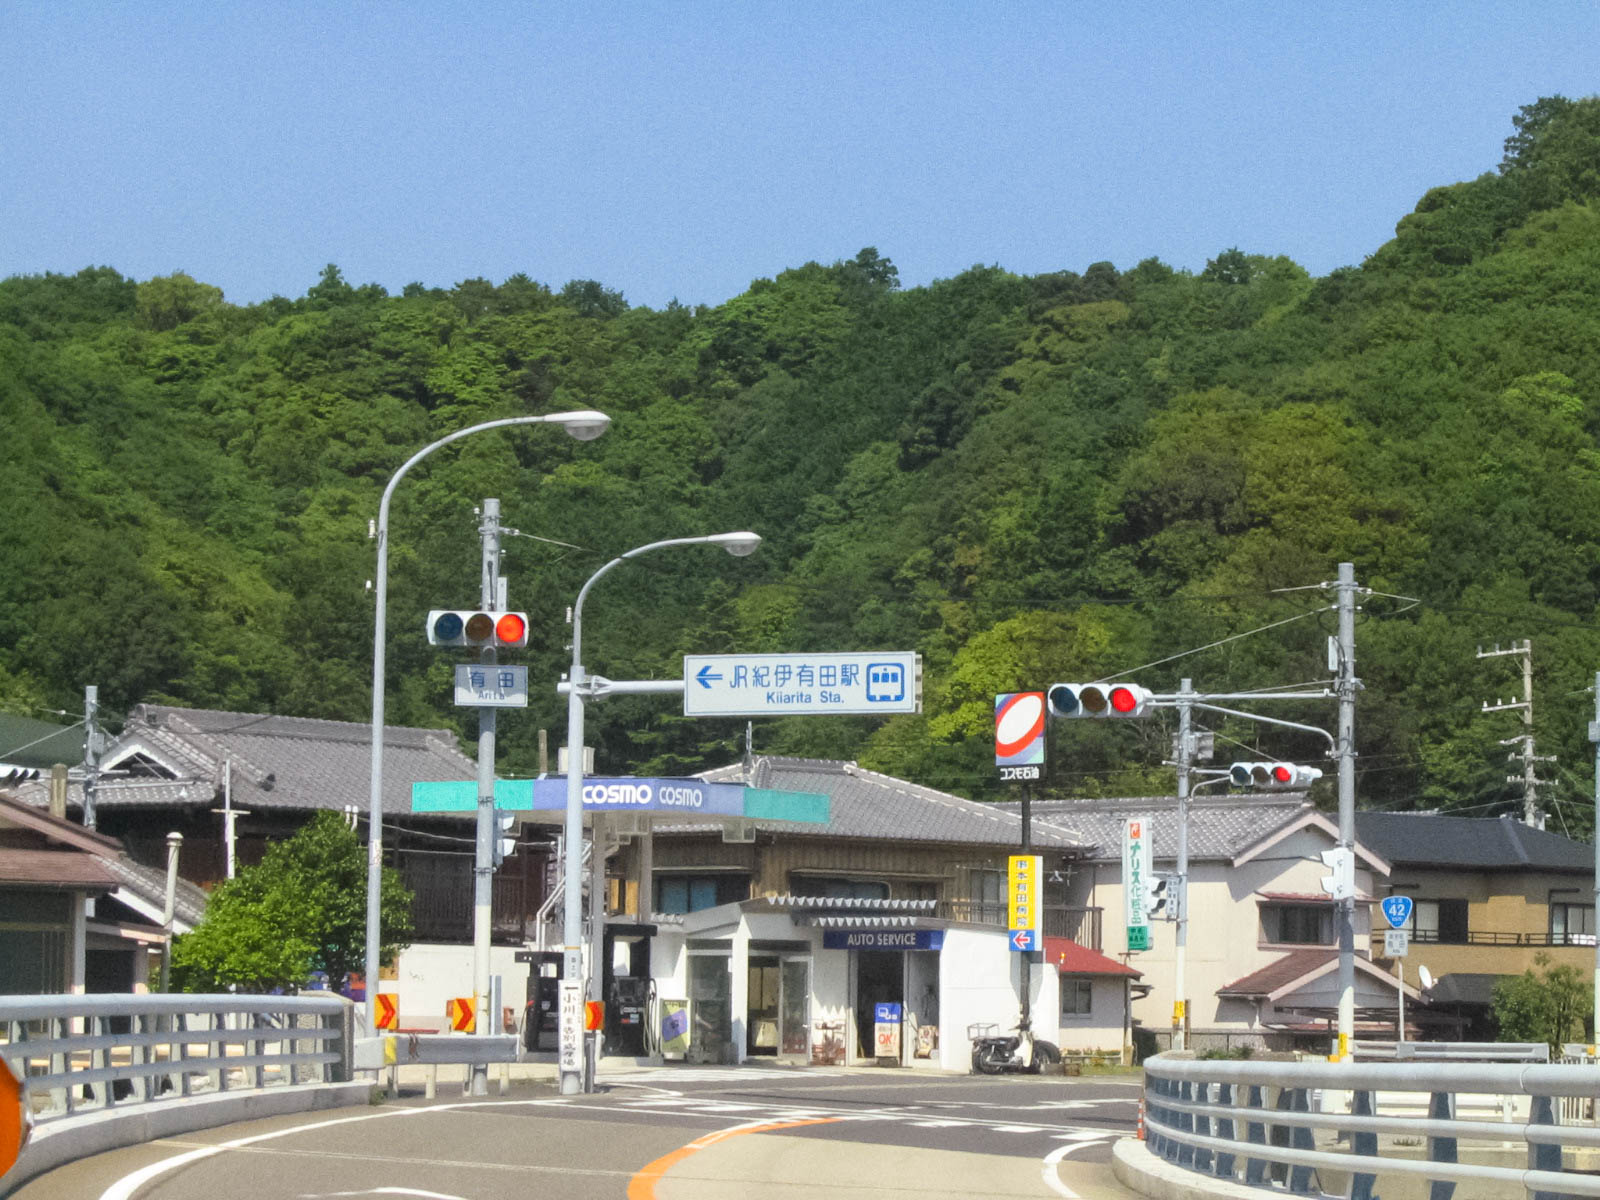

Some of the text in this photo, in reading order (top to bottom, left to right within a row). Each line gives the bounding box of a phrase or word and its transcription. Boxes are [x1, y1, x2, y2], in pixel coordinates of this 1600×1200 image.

[469, 671, 514, 688] 有田
[729, 664, 860, 688] JR紀伊有田駅
[766, 690, 845, 704] Kiiarita Sta.
[1000, 766, 1040, 781] コスモ石油
[582, 784, 653, 805] COSMO
[659, 786, 703, 808] COSMO
[1388, 903, 1406, 917] 42
[847, 932, 917, 946] AUTO SERVICE
